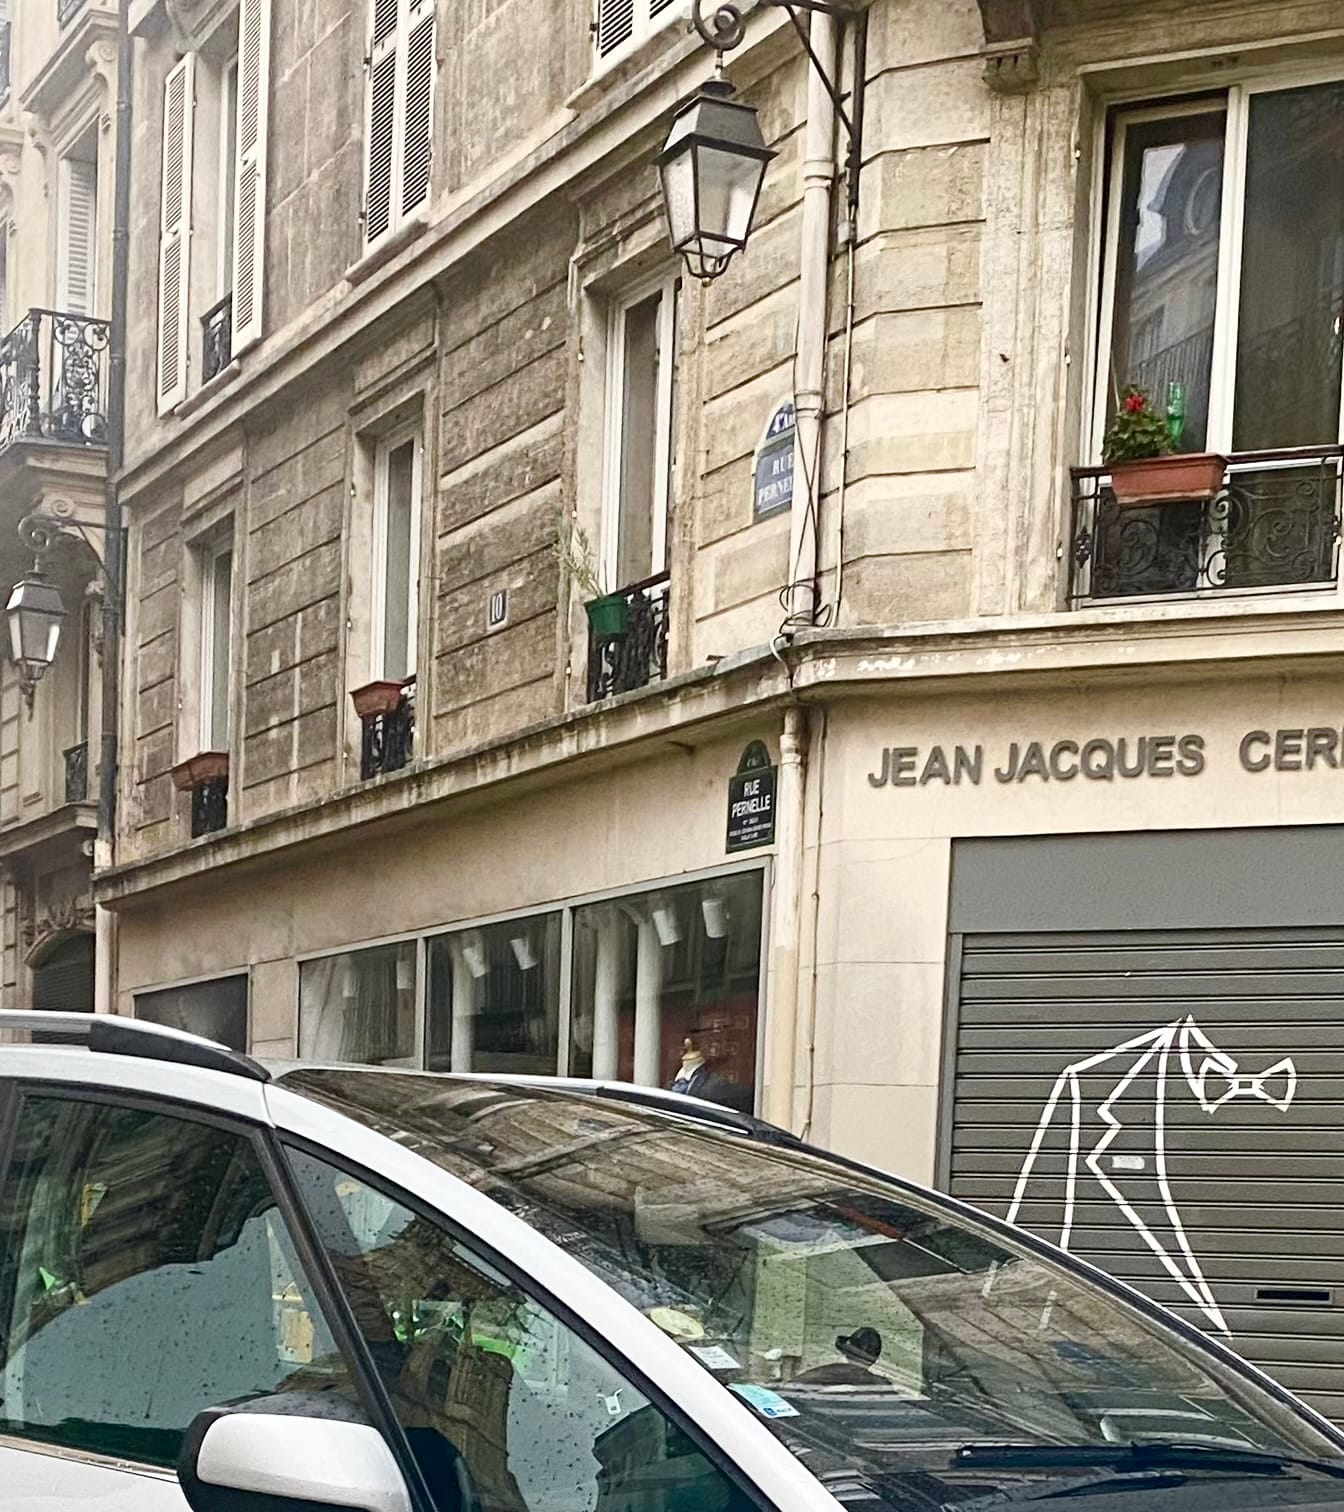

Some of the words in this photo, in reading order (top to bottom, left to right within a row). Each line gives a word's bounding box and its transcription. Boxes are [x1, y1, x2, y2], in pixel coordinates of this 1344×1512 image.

[490, 592, 503, 622] 10
[867, 744, 984, 788] JEAN
[993, 733, 1207, 785] JACQUES
[743, 779, 760, 797] RUE
[731, 794, 771, 818] PERNELLE
